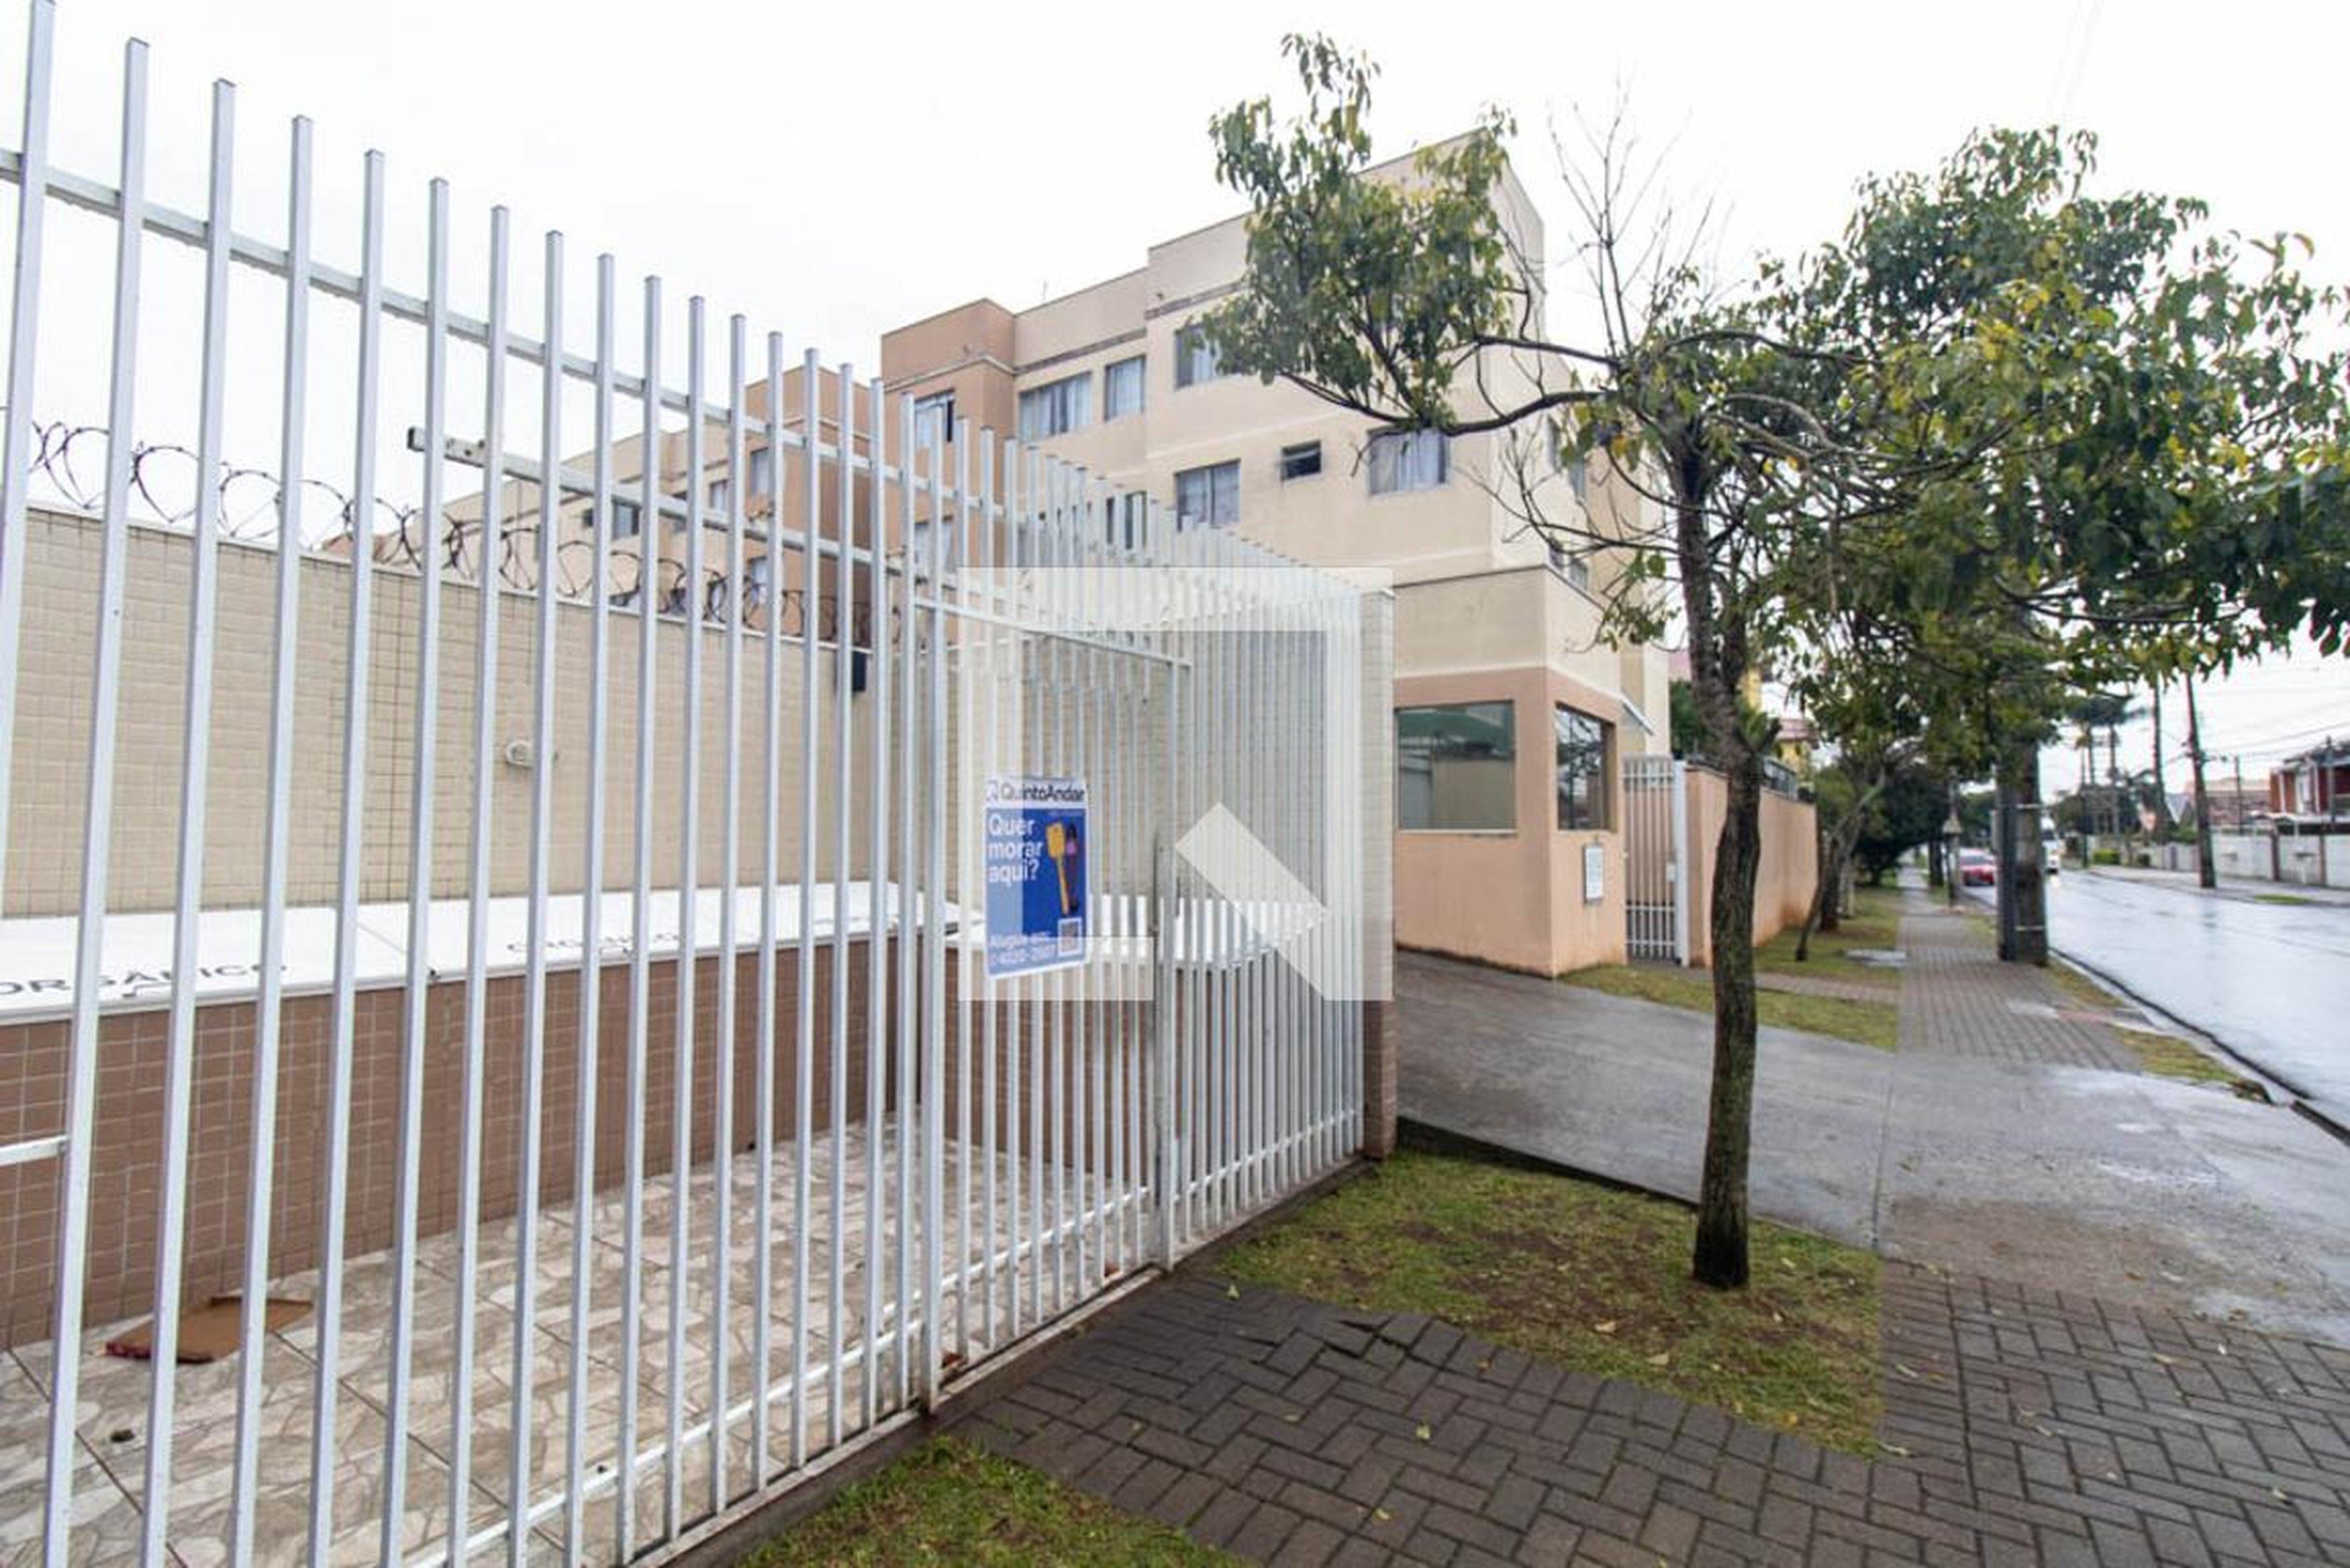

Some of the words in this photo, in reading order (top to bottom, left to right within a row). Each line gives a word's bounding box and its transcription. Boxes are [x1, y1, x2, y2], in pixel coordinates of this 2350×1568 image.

[988, 813, 1035, 836] Quer
[988, 840, 1043, 859] morar
[988, 857, 1040, 888] aqui?
